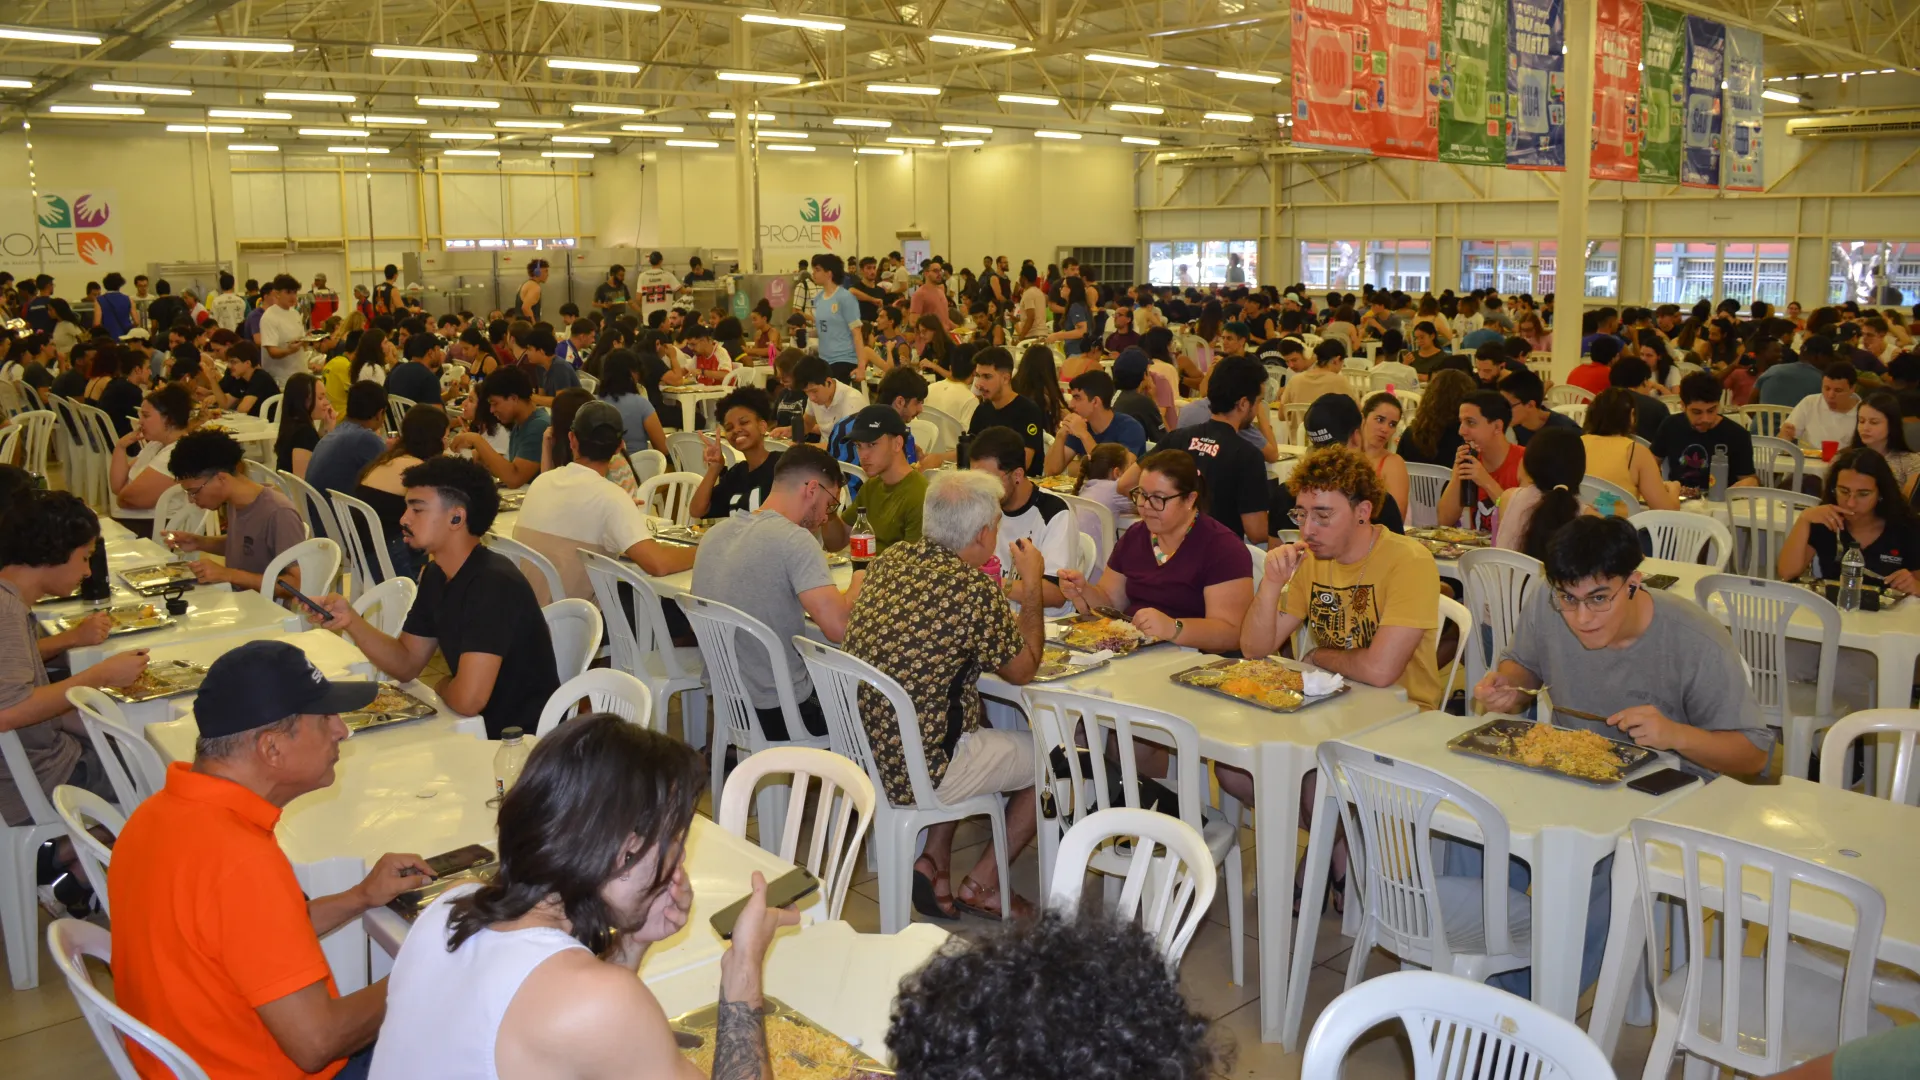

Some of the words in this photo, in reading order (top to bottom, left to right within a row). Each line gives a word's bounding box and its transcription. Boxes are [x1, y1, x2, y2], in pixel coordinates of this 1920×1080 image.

[1310, 46, 1348, 87] DOM
[0, 232, 75, 257] OAE
[819, 319, 828, 332] 15
